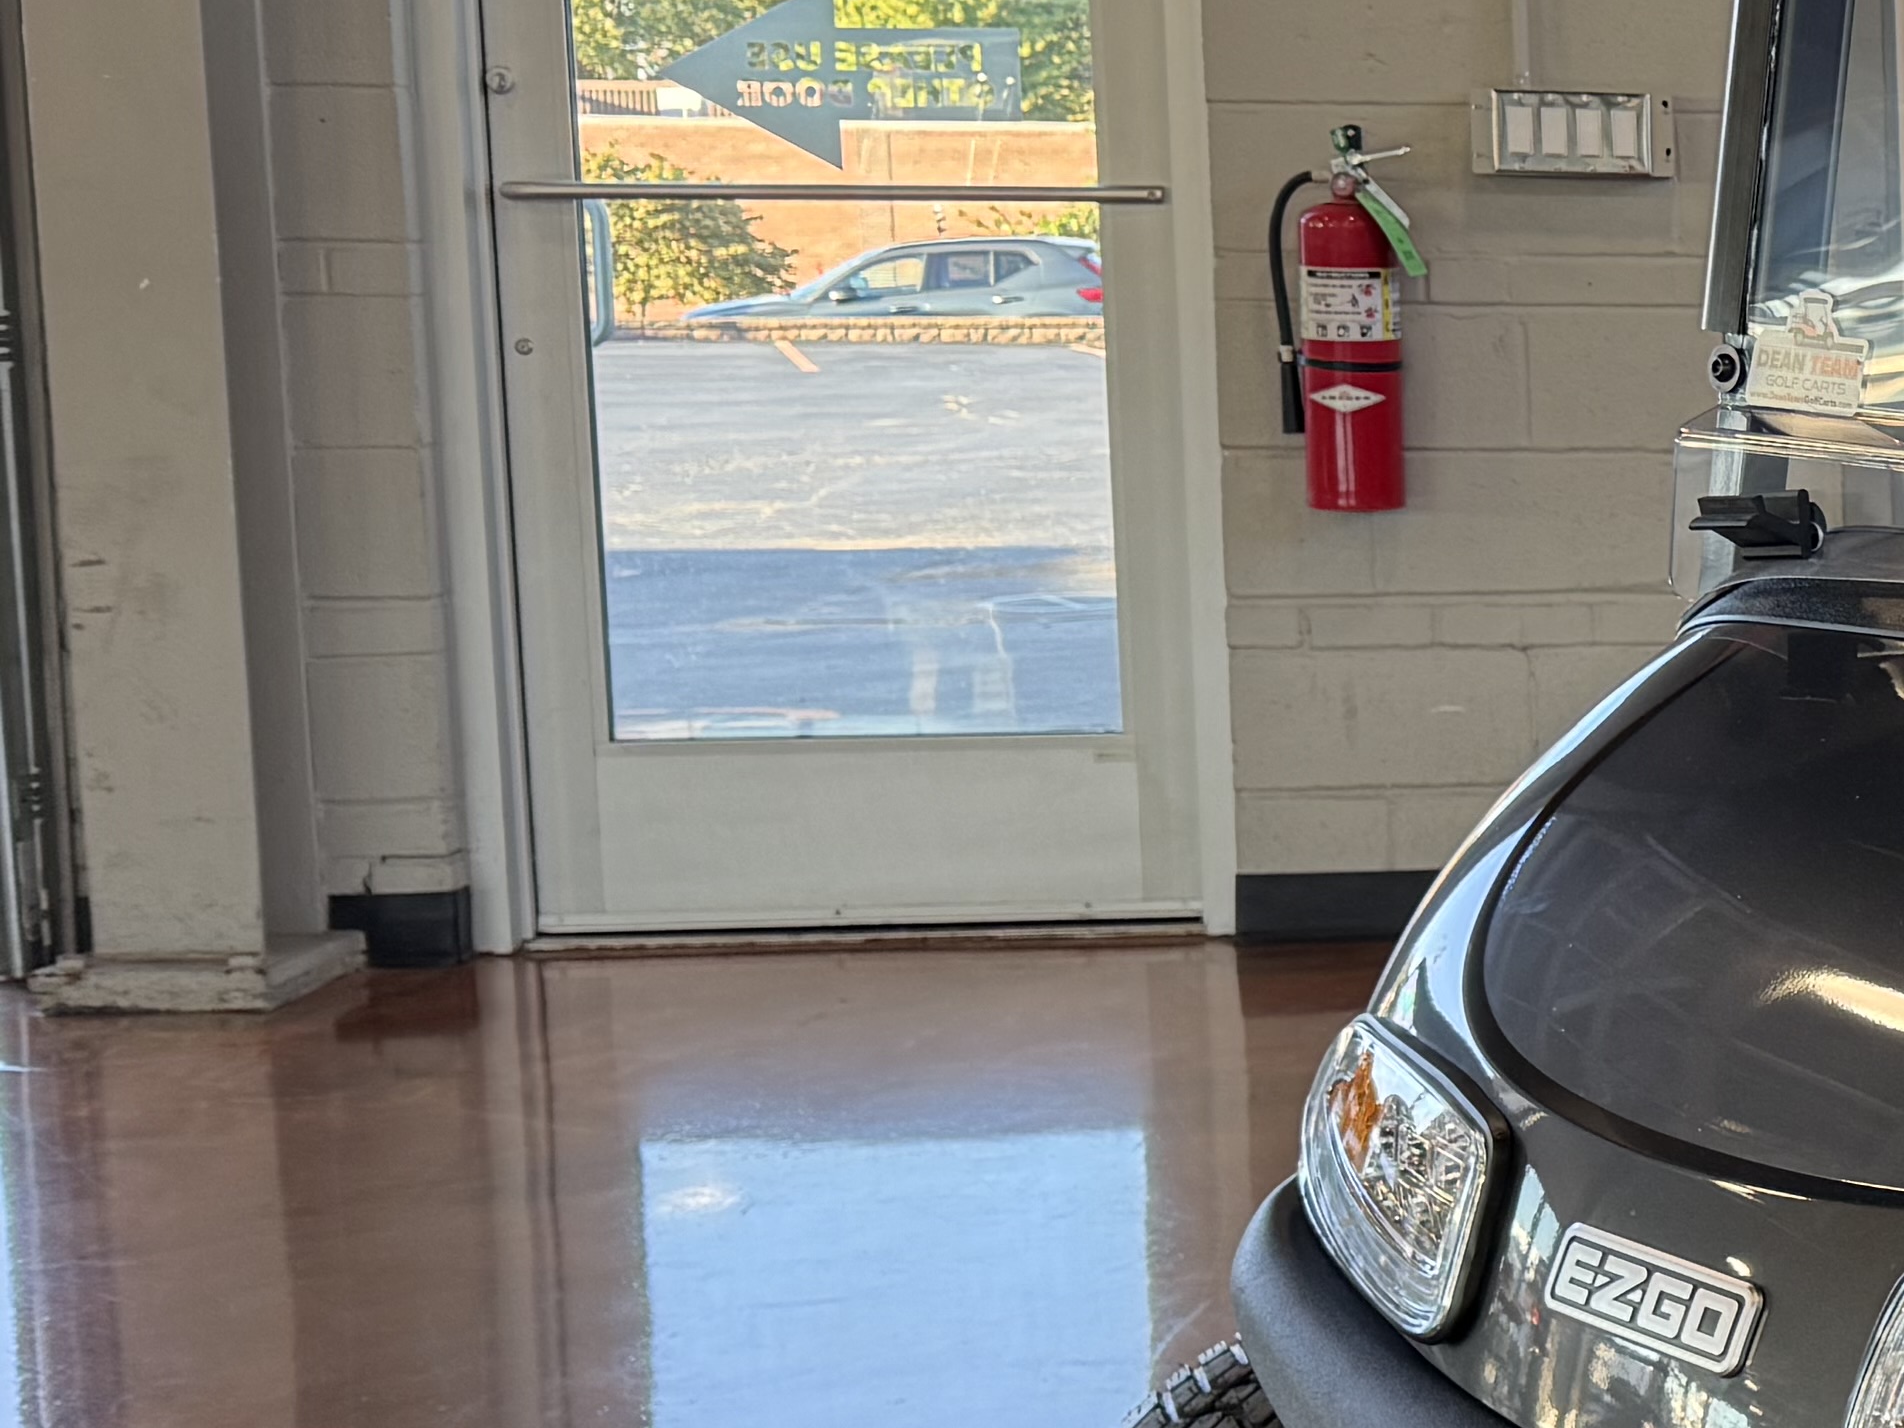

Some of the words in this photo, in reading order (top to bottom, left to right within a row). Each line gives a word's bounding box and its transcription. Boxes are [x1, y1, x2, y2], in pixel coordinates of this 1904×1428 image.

[1756, 348, 1807, 373] DEAN
[1810, 355, 1859, 380] TEAM
[1766, 374, 1799, 389] GOLF
[1801, 377, 1847, 395] CARTS
